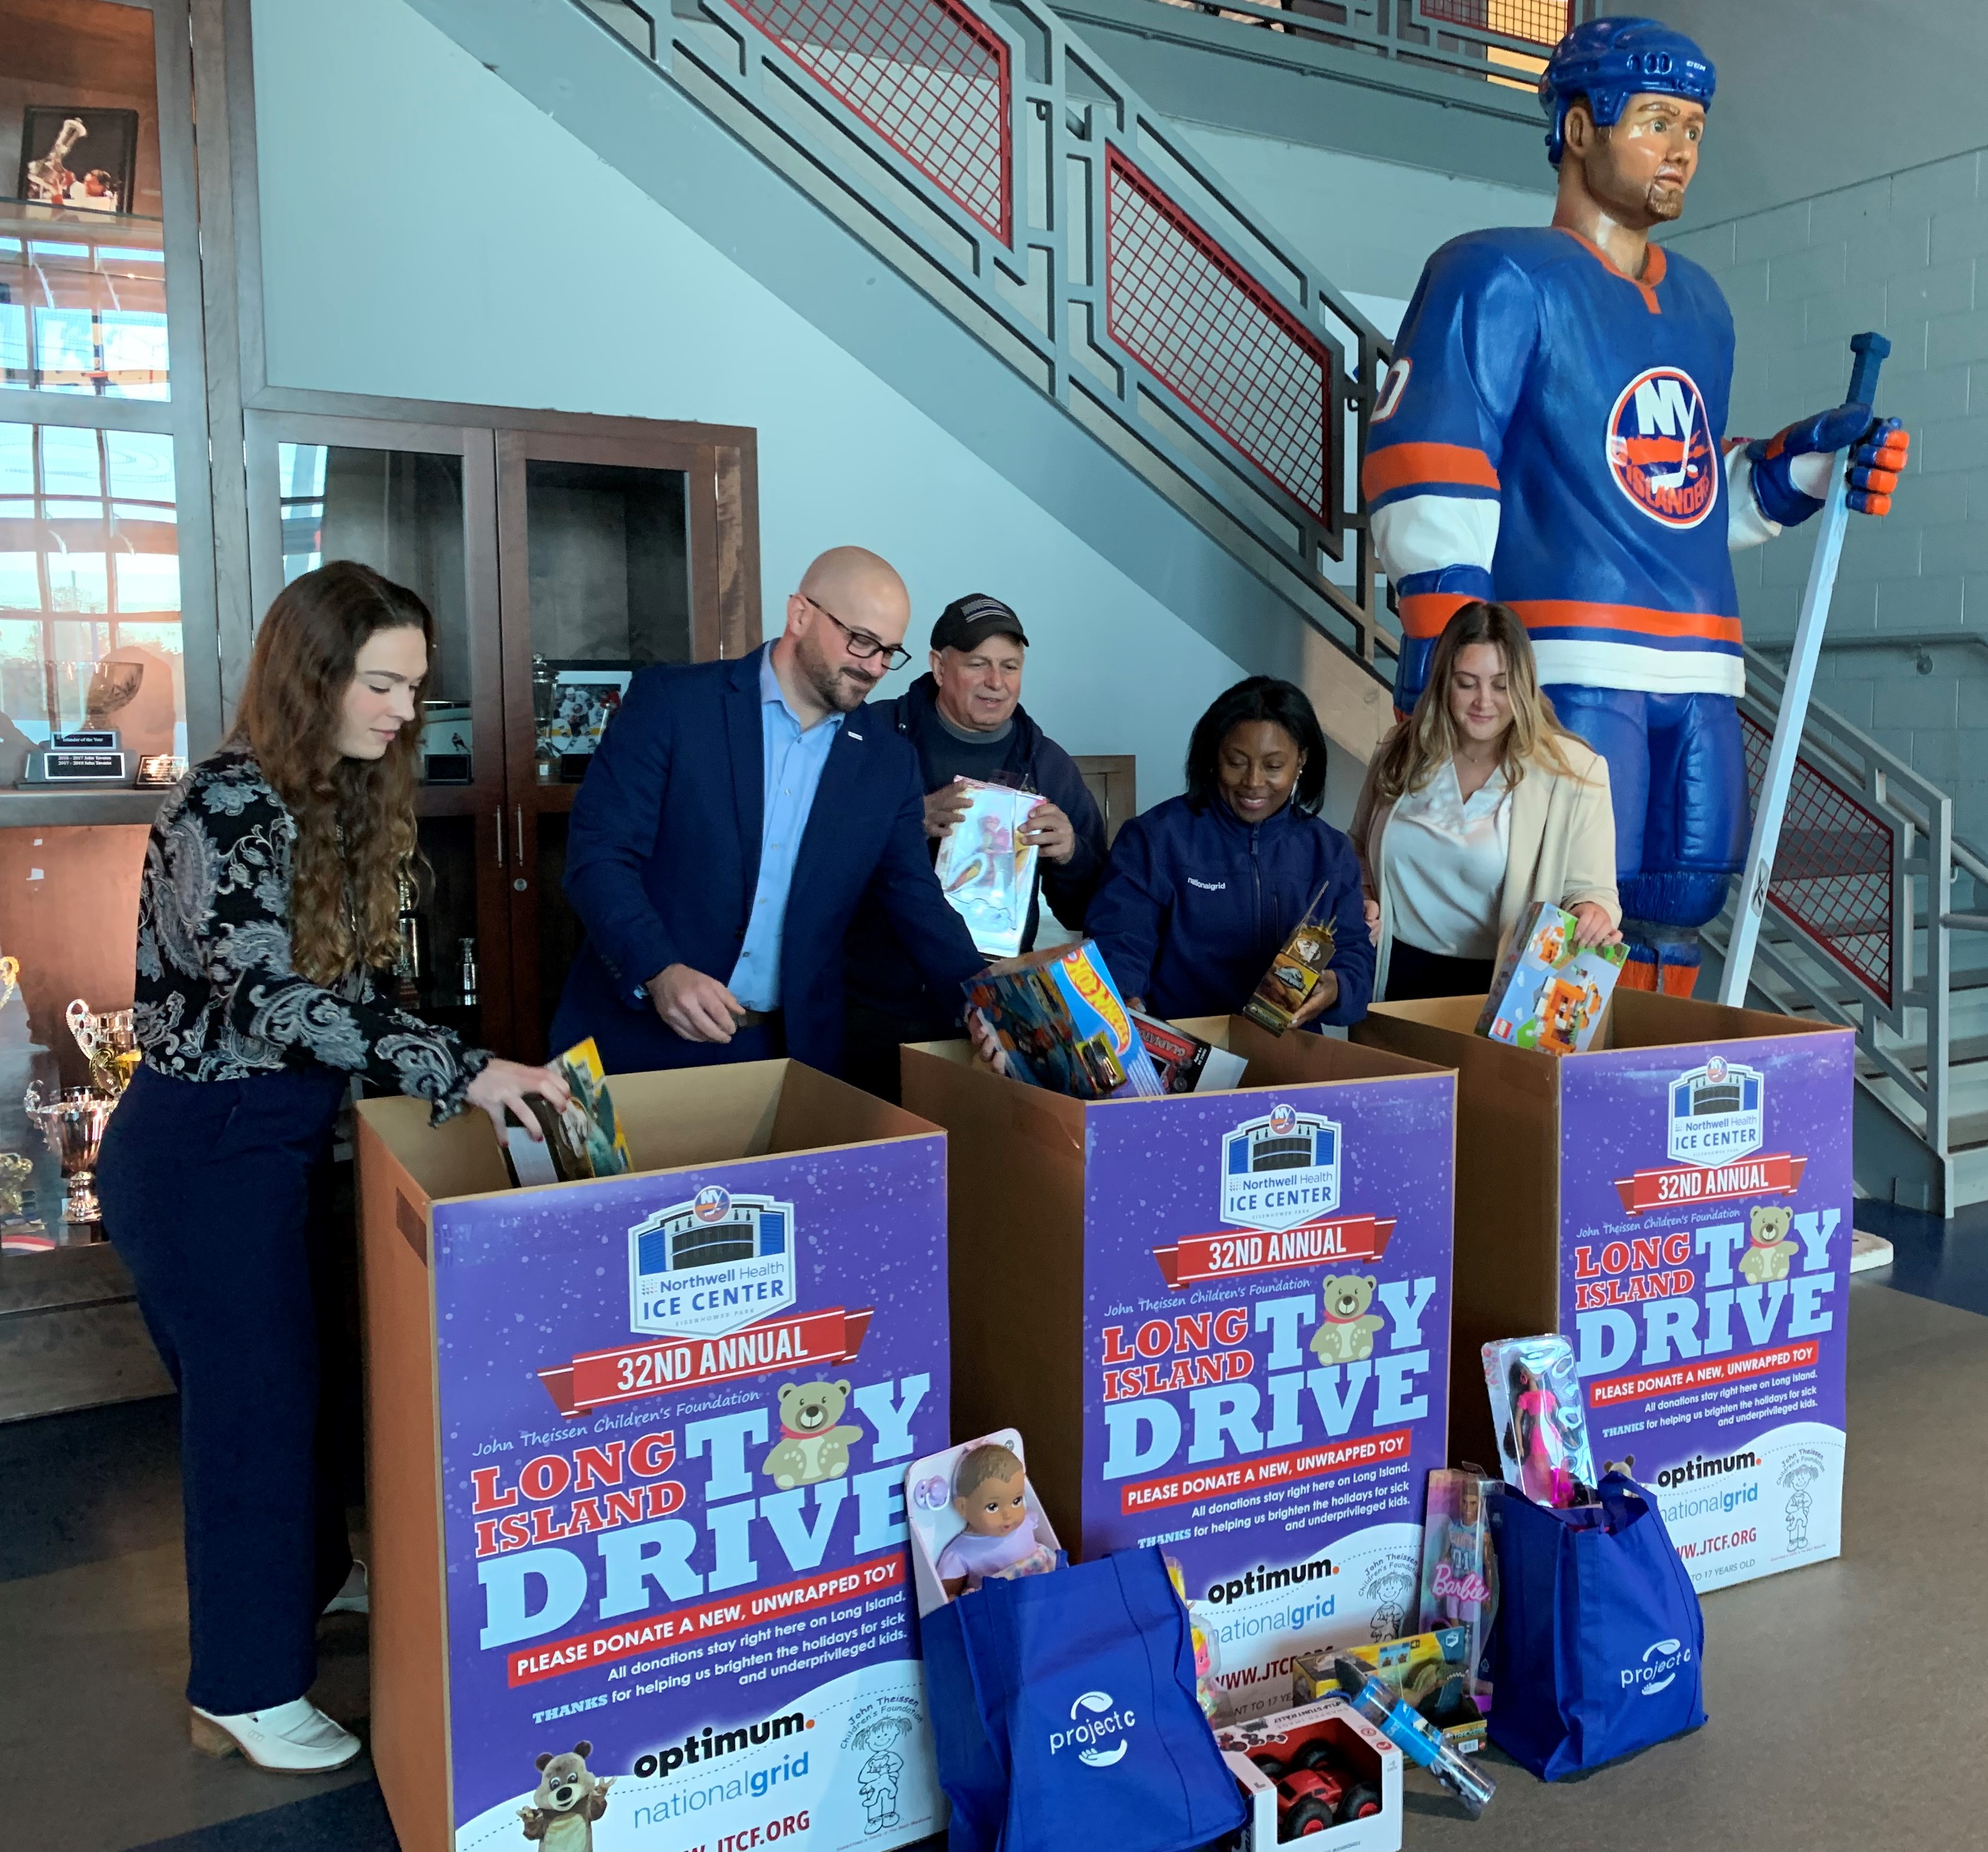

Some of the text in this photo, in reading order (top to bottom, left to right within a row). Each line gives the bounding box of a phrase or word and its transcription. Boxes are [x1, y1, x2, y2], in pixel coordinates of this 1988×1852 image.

[1635, 379, 1697, 436] NY
[1187, 877, 1226, 891] nationalgrid
[1138, 1027, 1186, 1057] GLADIATO
[1676, 1129, 1755, 1149] ICE CENTER
[1685, 1115, 1757, 1131] Northwell Health
[1231, 1186, 1330, 1211] ICE CENTER
[1242, 1170, 1332, 1191] Northwell Health
[1658, 1164, 1768, 1199] 32ND ANNUAL
[1576, 1208, 1739, 1237] John Theissen Children's Foundation
[1208, 1227, 1346, 1269] 32ND ANNUAL
[1575, 1232, 1690, 1280] LONG
[644, 1280, 783, 1319] ICE CENTER
[660, 1260, 784, 1293] Northwell Health
[1104, 1277, 1309, 1316] John Theissen Children's Foundation
[1576, 1269, 1695, 1310] ISLAND
[1102, 1306, 1249, 1366] LONG
[1576, 1272, 1836, 1378] DRIVE
[617, 1326, 807, 1389] 32ND ANNUAL
[1103, 1348, 1255, 1402] ISLAND
[1595, 1347, 1812, 1400] PLEASE DONATE A NEW, UNWRAPPED TOY
[472, 1391, 759, 1455] John Theissen Children's Foundation
[1103, 1348, 1428, 1480] DRIVE
[471, 1429, 677, 1514] LONG
[1129, 1437, 1403, 1505] PLEASE DONATE A NEW, UNWRAPPED TOY
[1192, 1462, 1409, 1517] All donations stay right here on Long Island.
[1657, 1451, 1762, 1489] optimum.
[475, 1479, 686, 1558] ISLAND
[1138, 1481, 1408, 1548] THANKS for helping us brighten the holidays for sick
[1285, 1496, 1409, 1530] and underprivileged kids.
[478, 1462, 907, 1651] DRIVE
[1690, 1558, 1756, 1584] TO 17 YEARS OLD
[1207, 1558, 1340, 1605] optimum.
[1433, 1564, 1489, 1601] Barbie
[518, 1563, 895, 1675] PLEASE DONATE A NEW, UNWRAPPED TOY
[608, 1590, 905, 1681] All donations stay right here on Long Island.
[532, 1613, 905, 1723] THANKS for helping us brighten the holidays for sick
[739, 1629, 906, 1684] and underprivileged kids.
[840, 1704, 924, 1751] Children's Foundation
[847, 1694, 919, 1726] John Theissen
[1251, 1701, 1265, 1712] TO
[1268, 1696, 1276, 1707] 17
[633, 1711, 816, 1779] optimum.
[633, 1751, 809, 1828] nationalgrid
